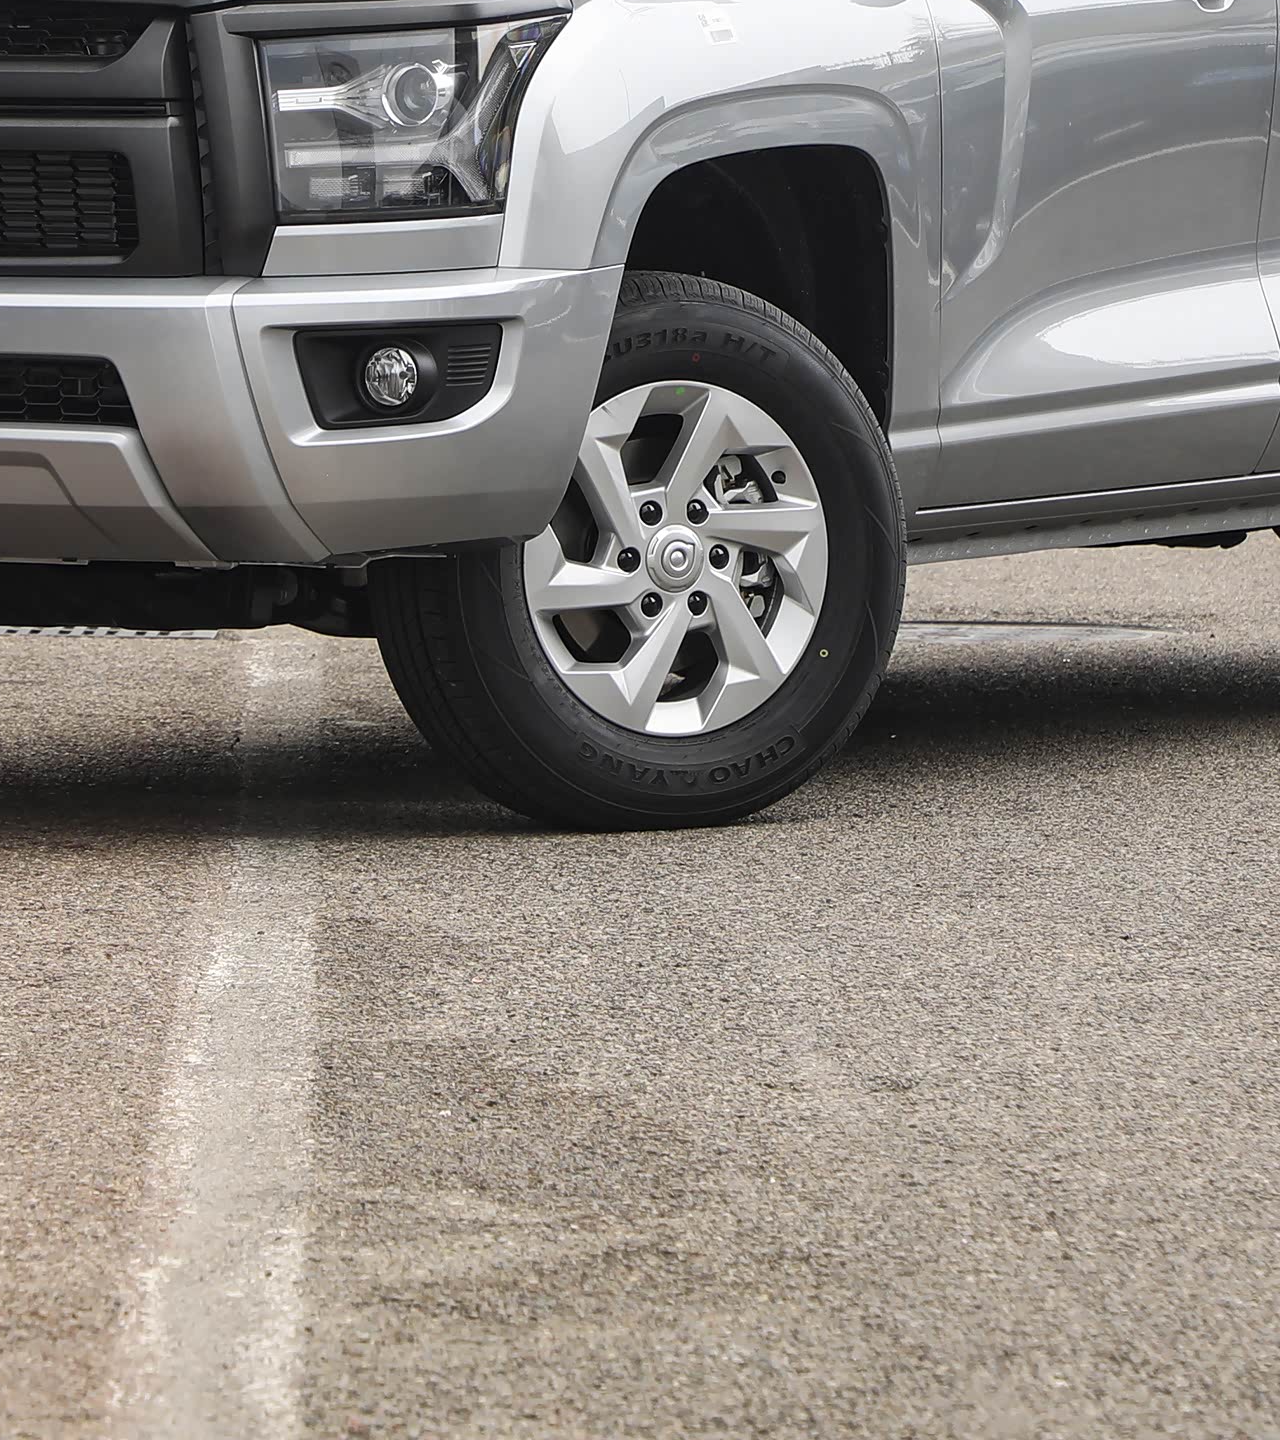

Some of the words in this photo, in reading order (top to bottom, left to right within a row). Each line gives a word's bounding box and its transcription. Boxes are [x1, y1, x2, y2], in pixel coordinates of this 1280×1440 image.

[604, 327, 709, 361] U318a
[723, 332, 777, 360] H/T
[577, 740, 670, 785] YANG
[707, 734, 796, 785] CHAO
